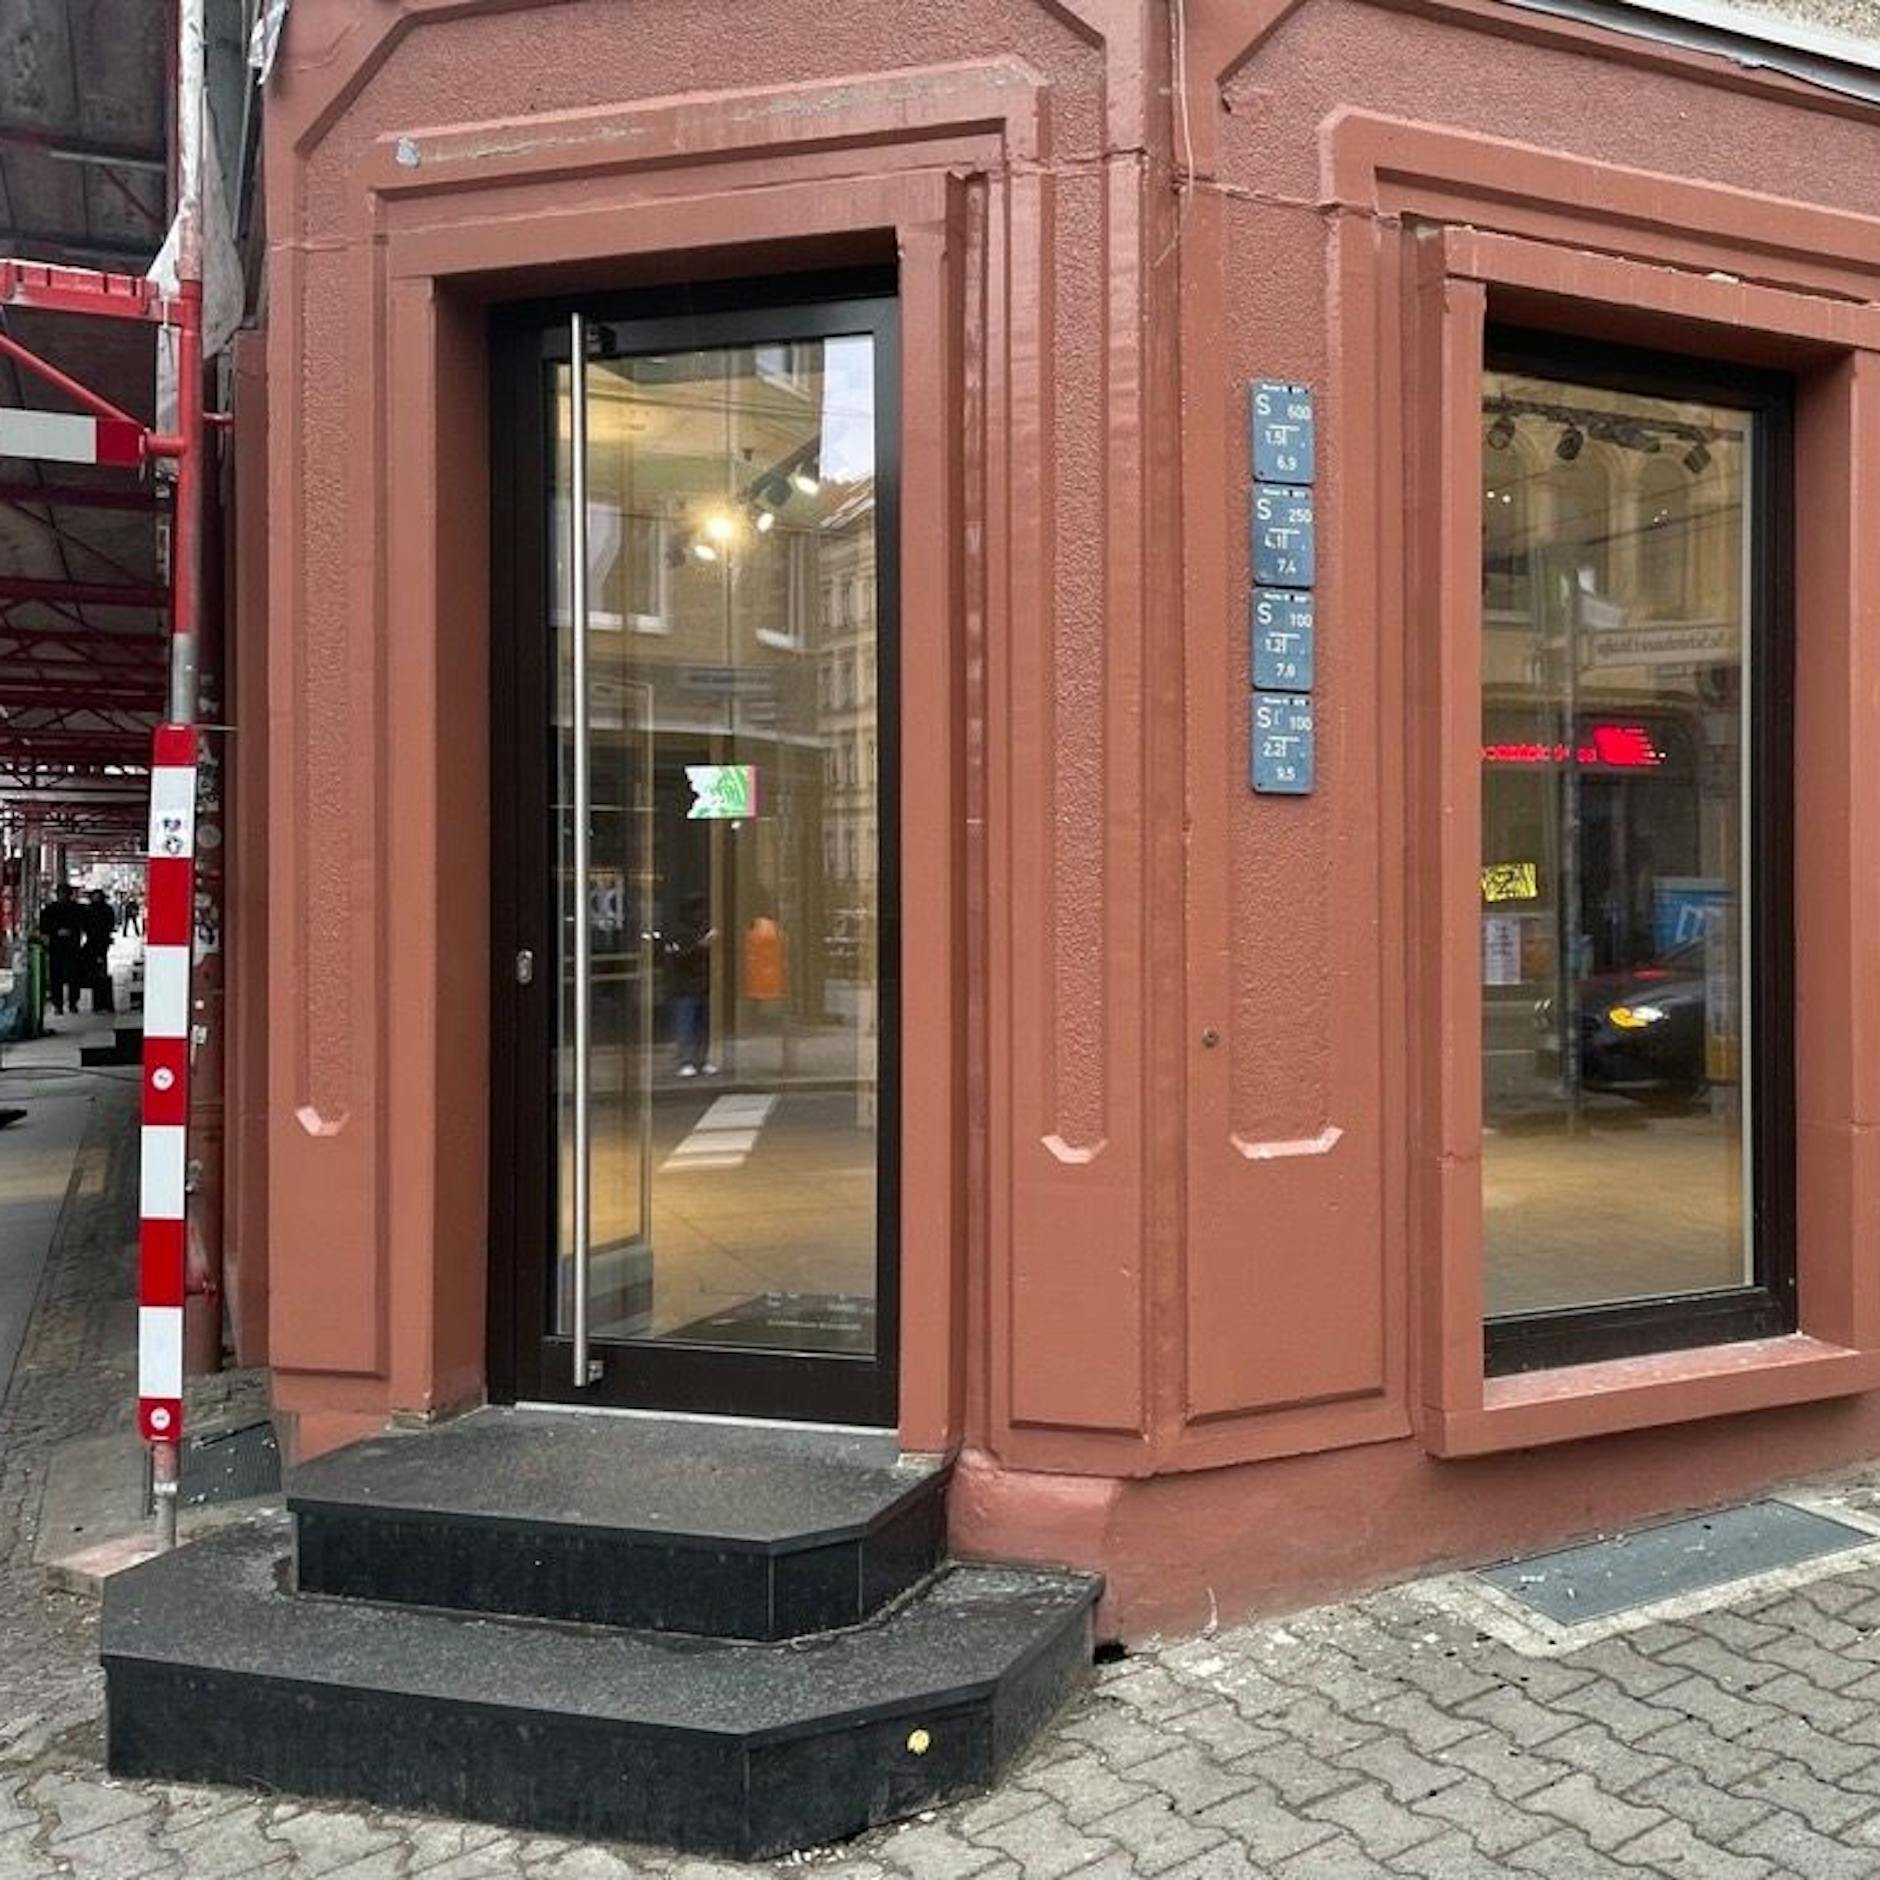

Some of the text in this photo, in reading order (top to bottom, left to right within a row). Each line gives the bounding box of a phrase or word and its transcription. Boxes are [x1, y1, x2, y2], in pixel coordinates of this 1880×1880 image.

[1255, 393, 1272, 416] S
[1256, 498, 1313, 523] S 250
[1256, 602, 1313, 628] S 100
[1256, 706, 1272, 728] S
